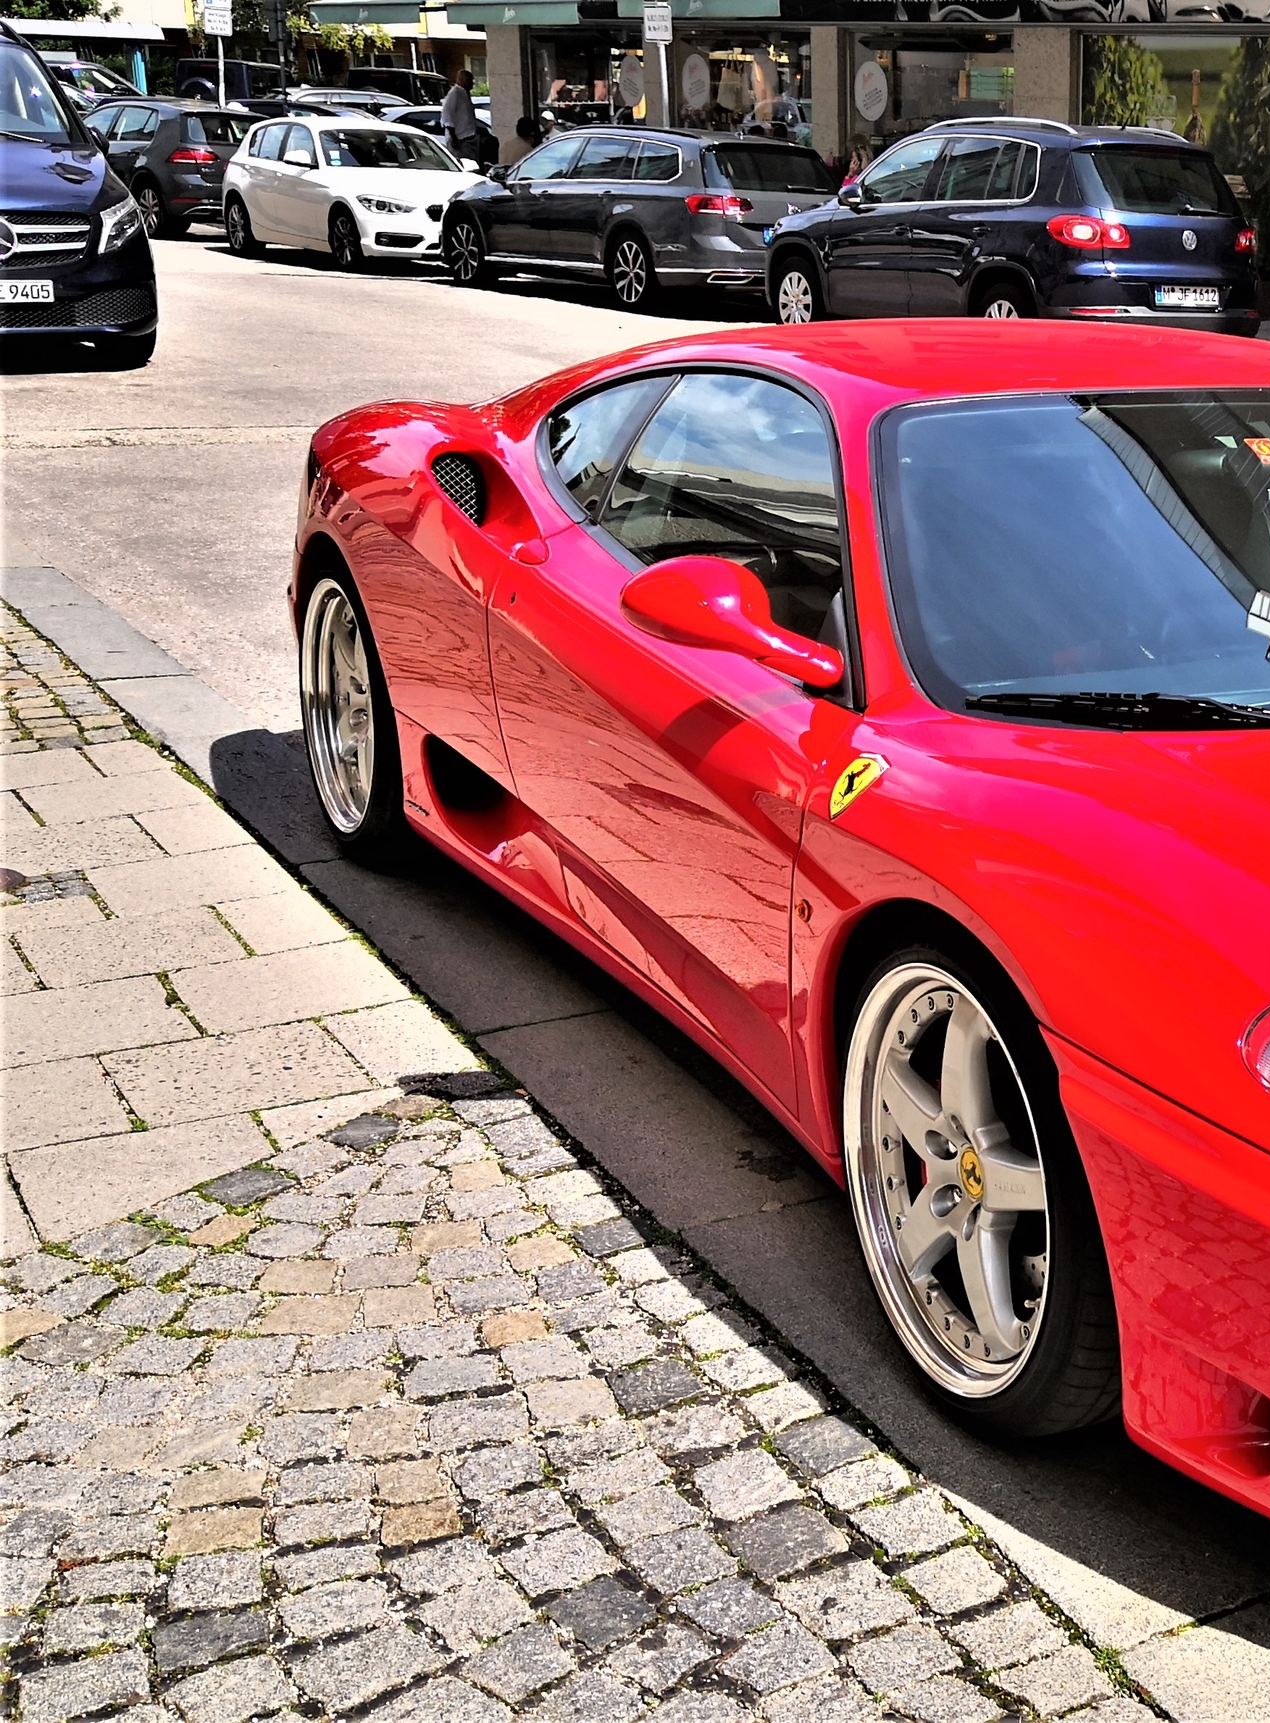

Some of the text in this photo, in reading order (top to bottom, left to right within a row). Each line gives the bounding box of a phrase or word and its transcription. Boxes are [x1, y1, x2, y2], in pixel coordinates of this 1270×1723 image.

[9, 284, 50, 300] 9405
[1162, 287, 1217, 302] M JF 1612
